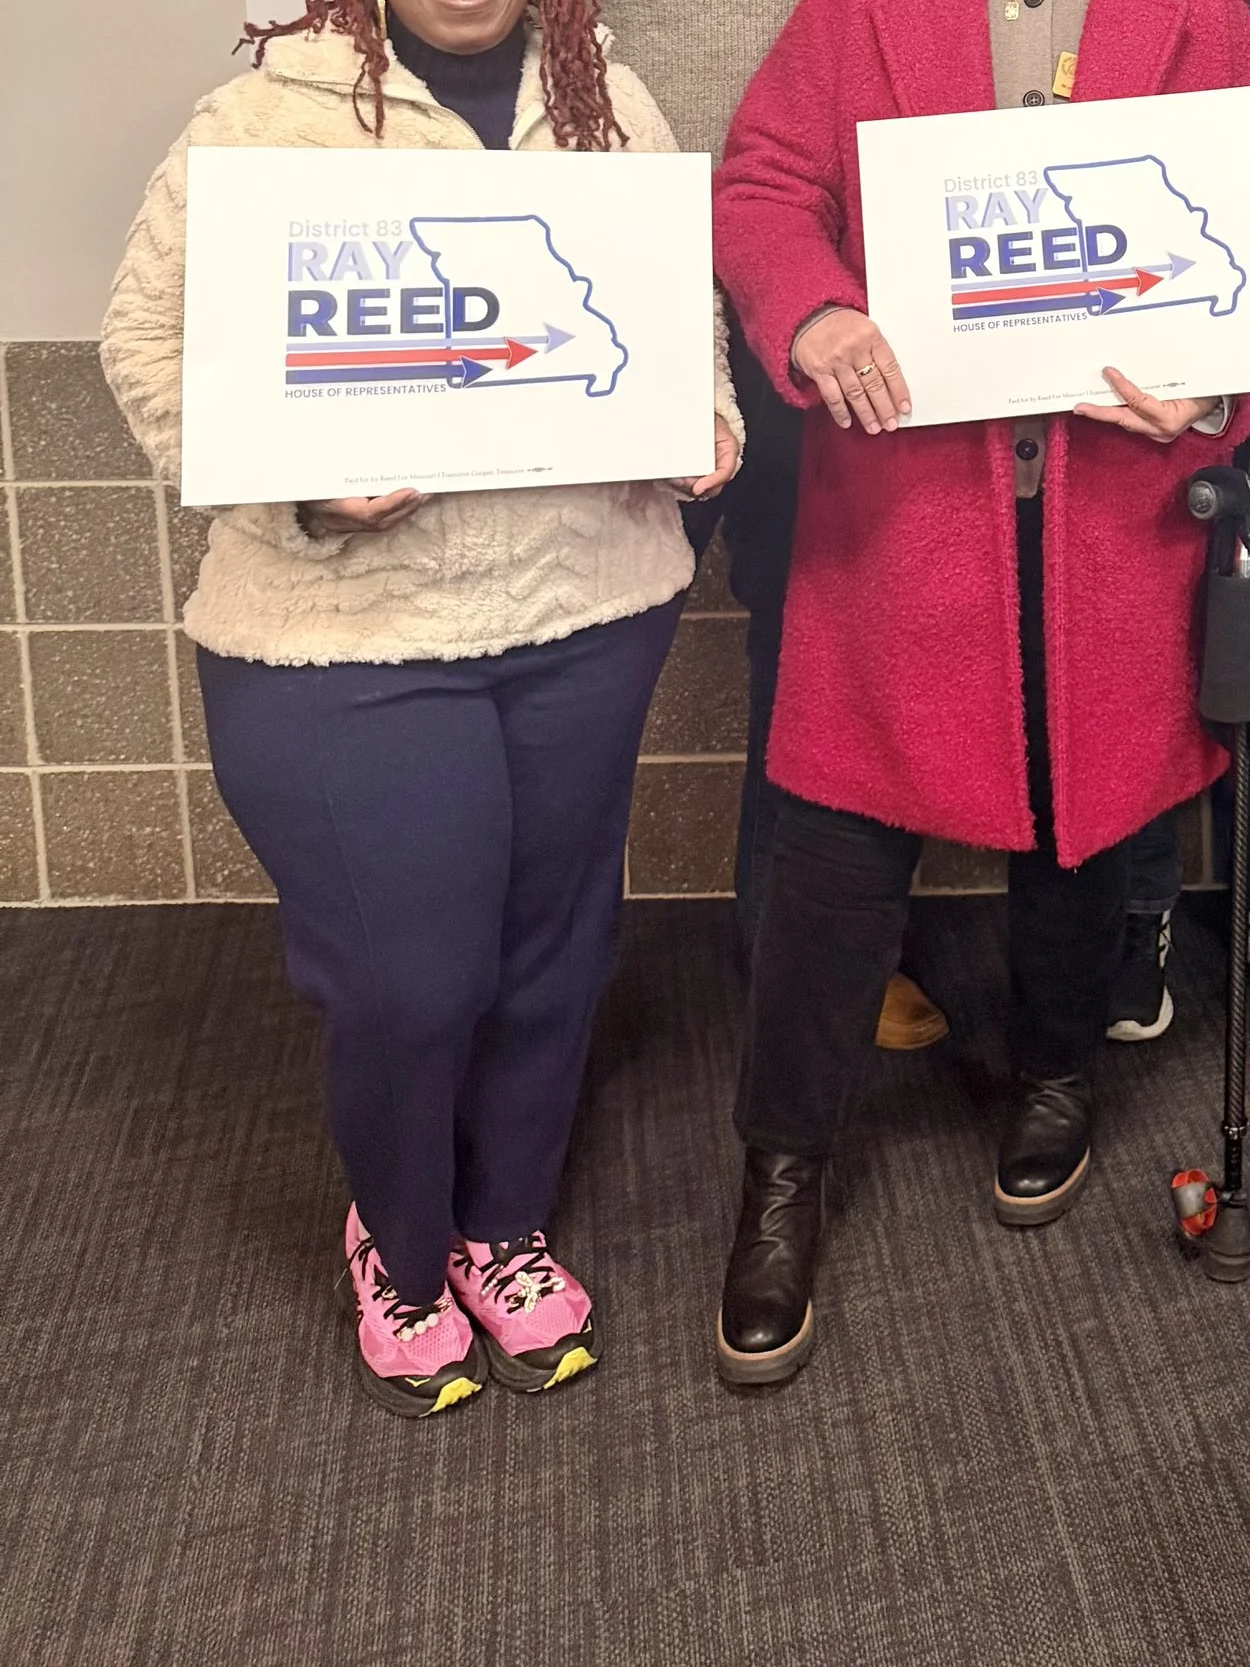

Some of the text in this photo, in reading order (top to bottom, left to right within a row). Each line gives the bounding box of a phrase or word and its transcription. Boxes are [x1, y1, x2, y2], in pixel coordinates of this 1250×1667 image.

[944, 171, 1038, 192] District 83
[945, 188, 1048, 231] RAY
[289, 219, 402, 237] District 83
[288, 240, 414, 282] RAY
[949, 224, 1128, 279] REED
[288, 287, 500, 337] REED
[953, 312, 1087, 333] HOUSE OF REPRESENTATIVES
[285, 384, 446, 398] HOUSE OF REPRESENTATIVES
